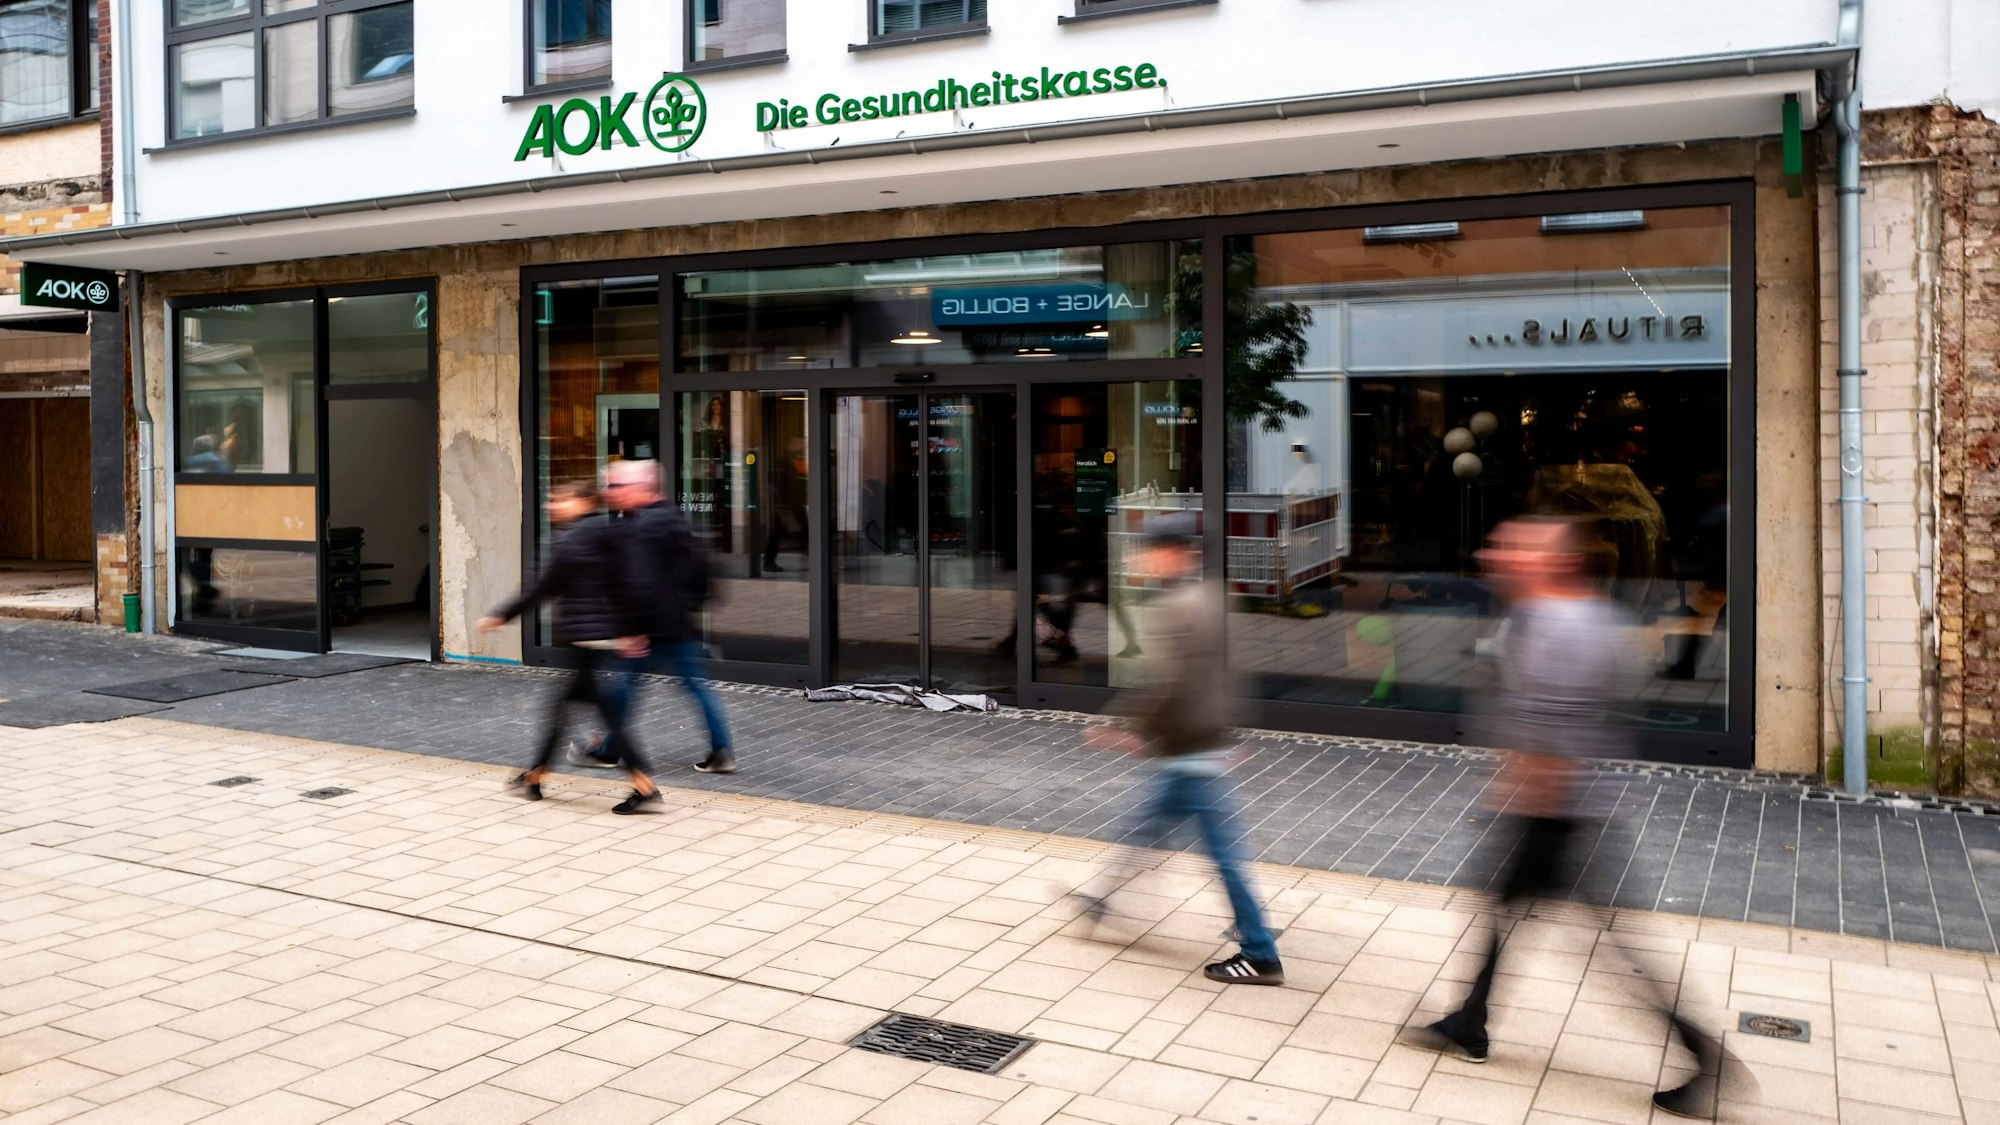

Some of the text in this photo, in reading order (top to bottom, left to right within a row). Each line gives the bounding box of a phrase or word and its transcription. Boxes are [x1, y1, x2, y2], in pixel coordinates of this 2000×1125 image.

[514, 92, 641, 161] AOK
[757, 62, 1168, 132] Die Gesundheitskasse.
[36, 279, 86, 300] AOK
